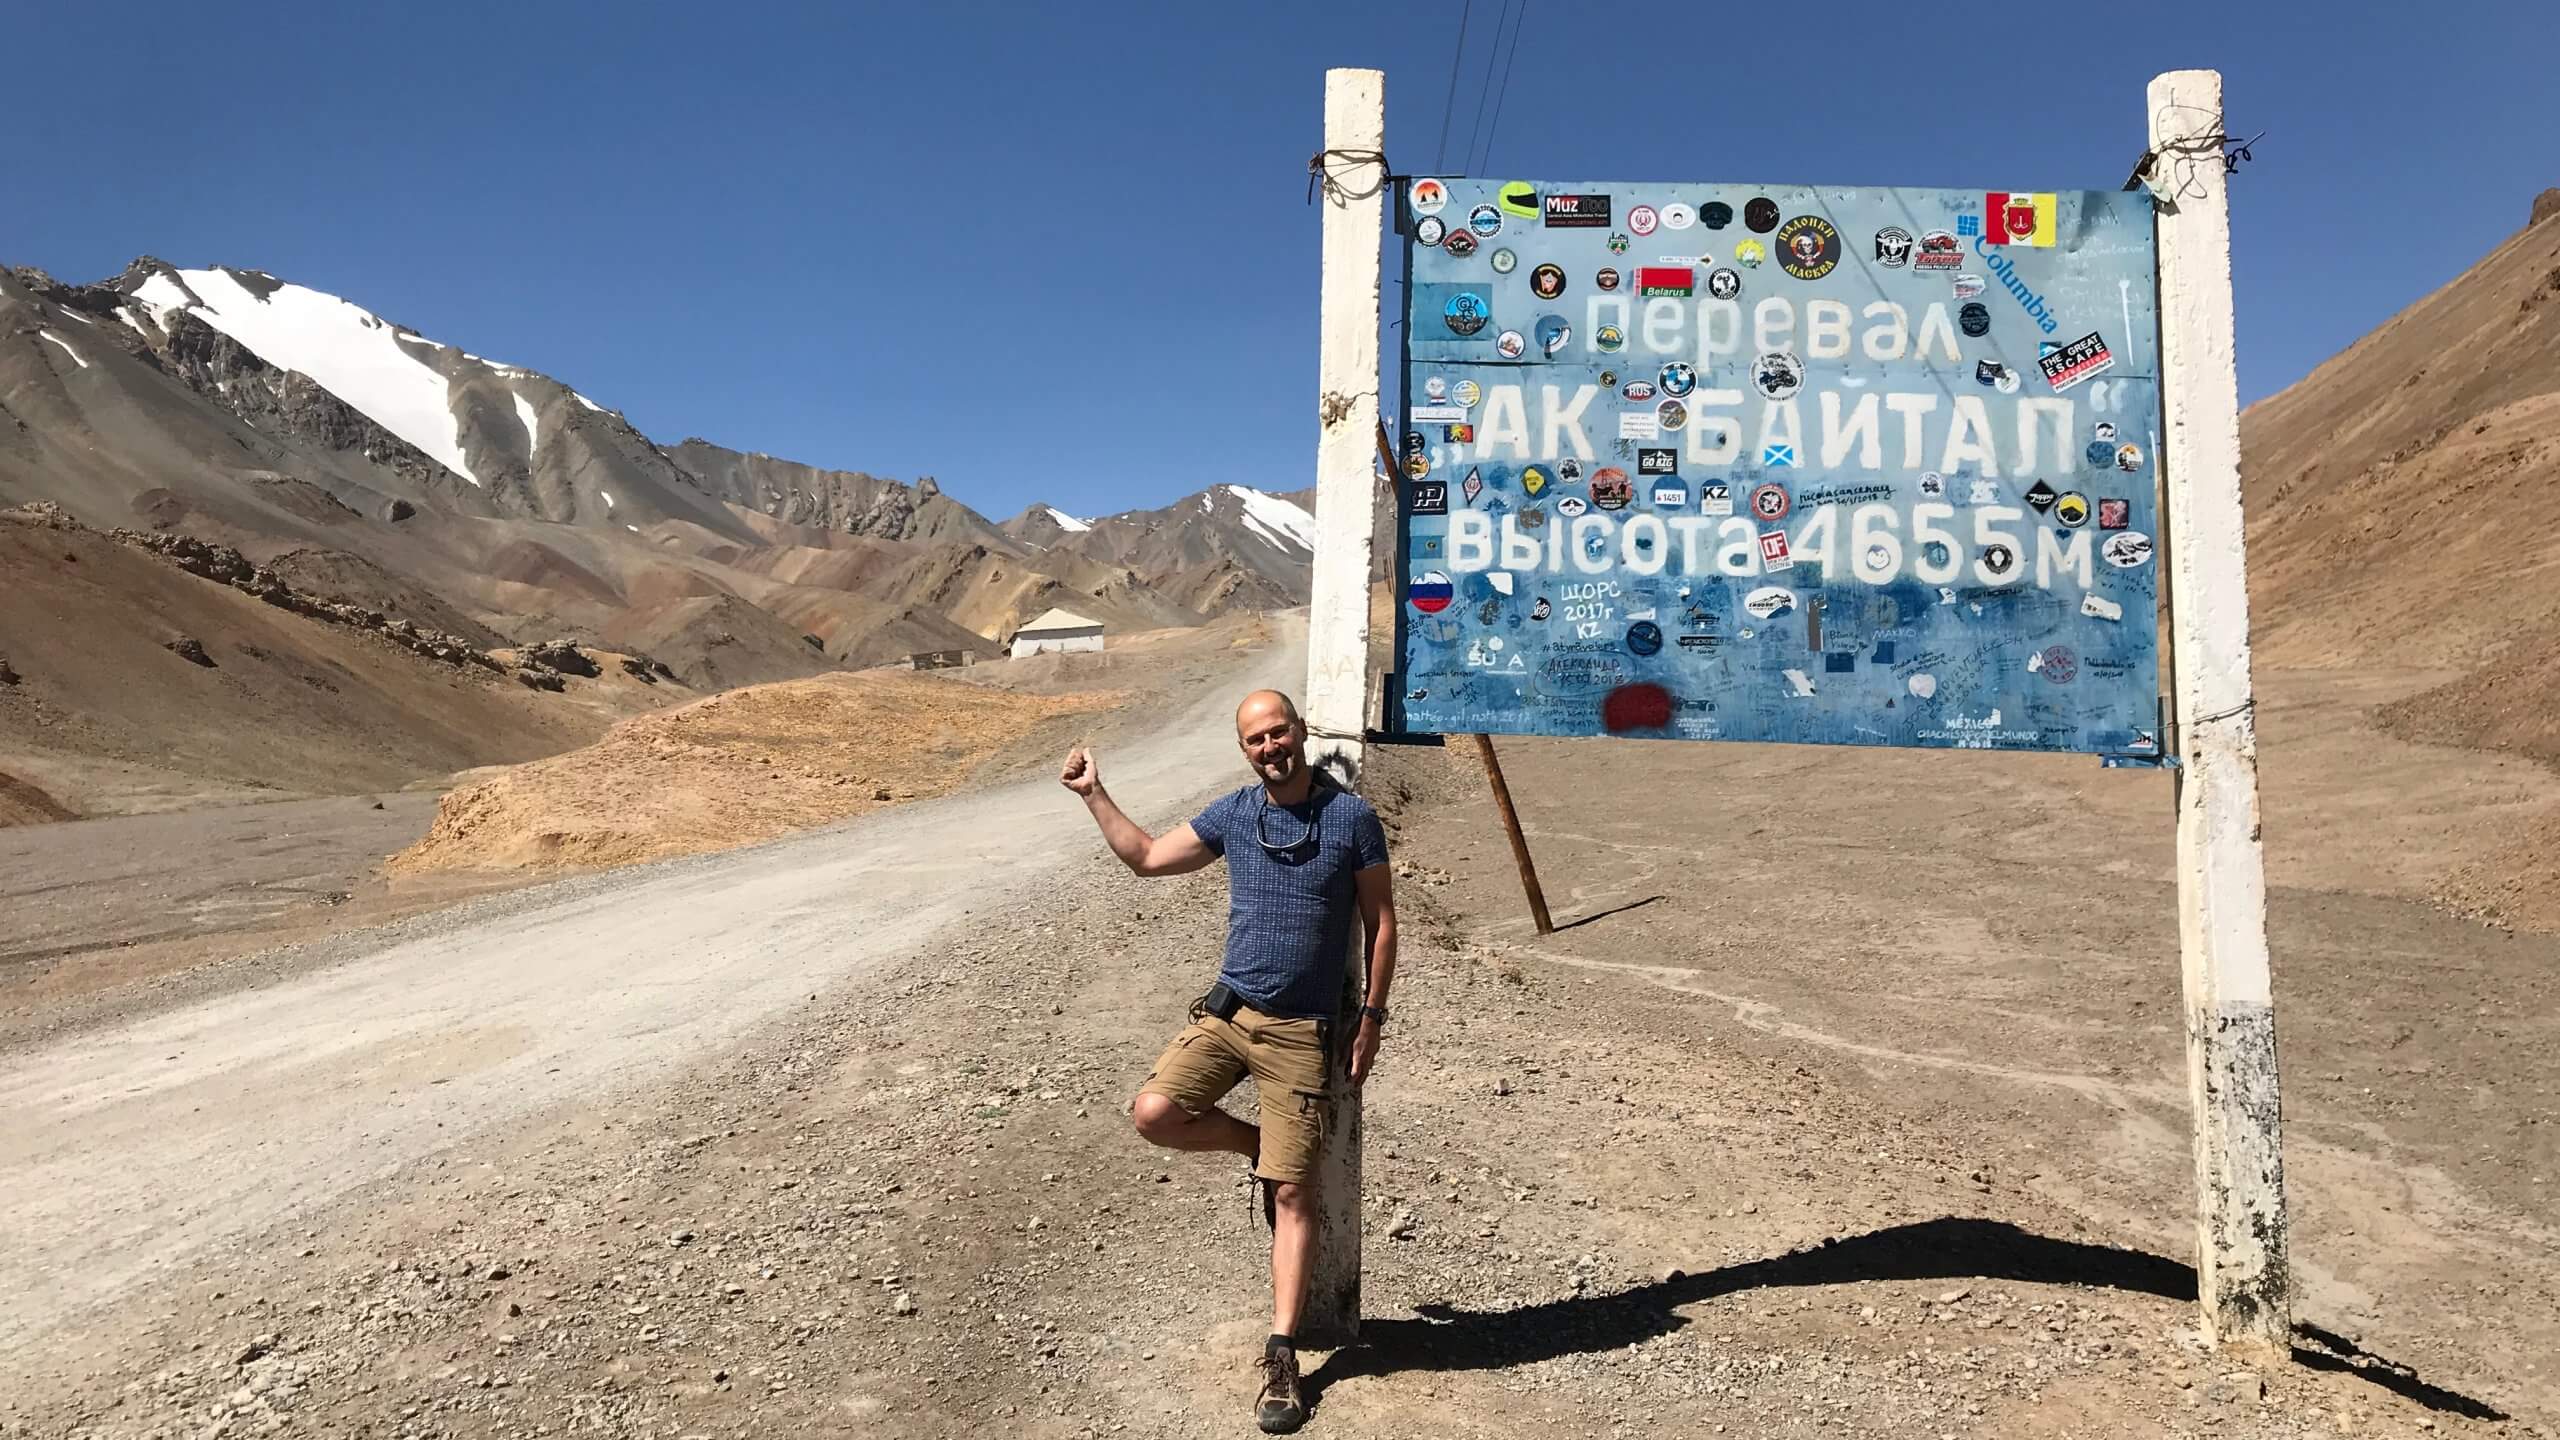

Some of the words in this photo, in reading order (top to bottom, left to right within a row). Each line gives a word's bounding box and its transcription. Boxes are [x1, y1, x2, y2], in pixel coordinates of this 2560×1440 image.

[1647, 287, 1685, 296] Belarus
[1975, 235, 2057, 334] Columbia
[2042, 353, 2063, 368] THE
[2067, 335, 2099, 356] GREAT
[2046, 343, 2105, 377] ESCAPE
[1629, 385, 1651, 396] RUS
[1642, 457, 1655, 467] GO
[1656, 457, 1673, 467] BIG
[1663, 493, 1681, 502] 1451
[1703, 487, 1729, 500] KZ
[1561, 580, 1621, 602] ЩОРС
[1563, 603, 1614, 621] 2017г
[1576, 622, 1602, 639] KZ
